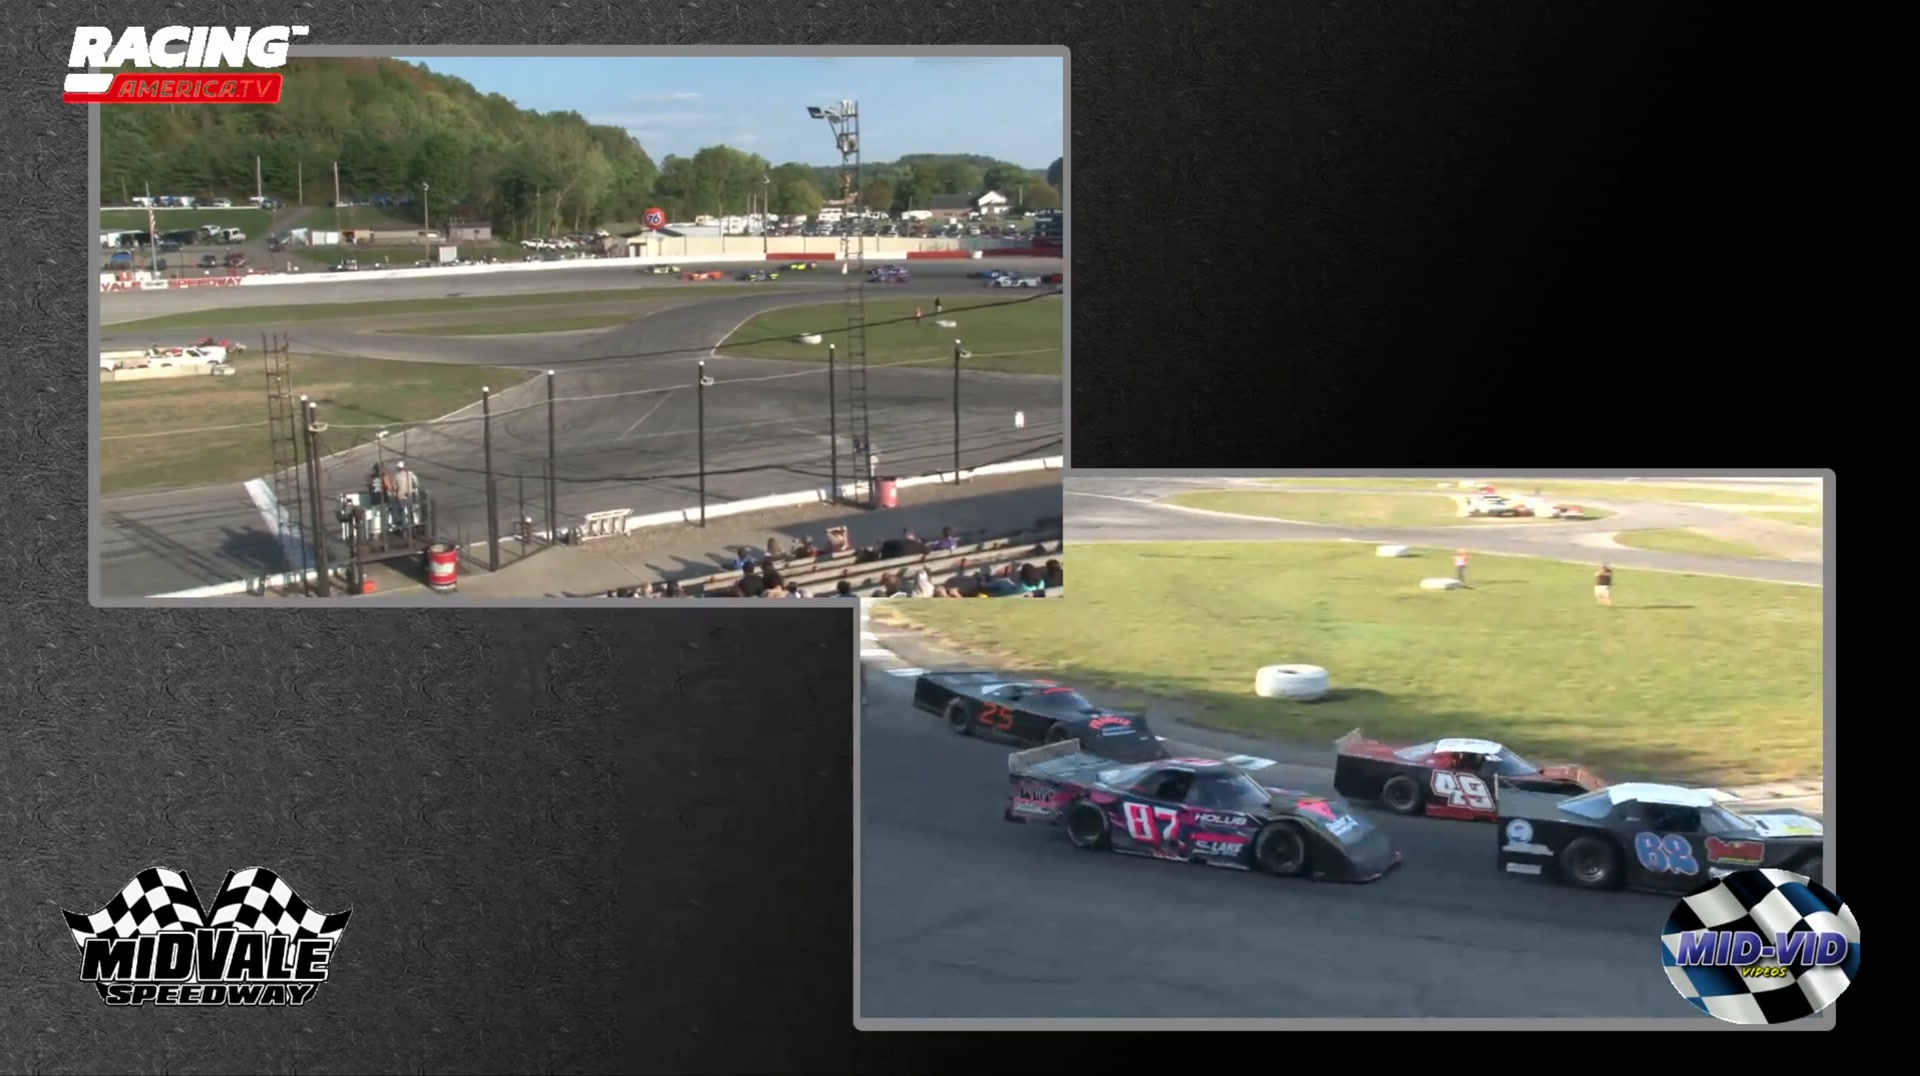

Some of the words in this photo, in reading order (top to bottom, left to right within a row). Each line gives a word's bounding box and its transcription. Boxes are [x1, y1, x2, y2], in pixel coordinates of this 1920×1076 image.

[645, 212, 662, 226] 76
[980, 701, 1013, 729] 25
[1430, 769, 1496, 812] 49
[1123, 801, 1181, 845] 87
